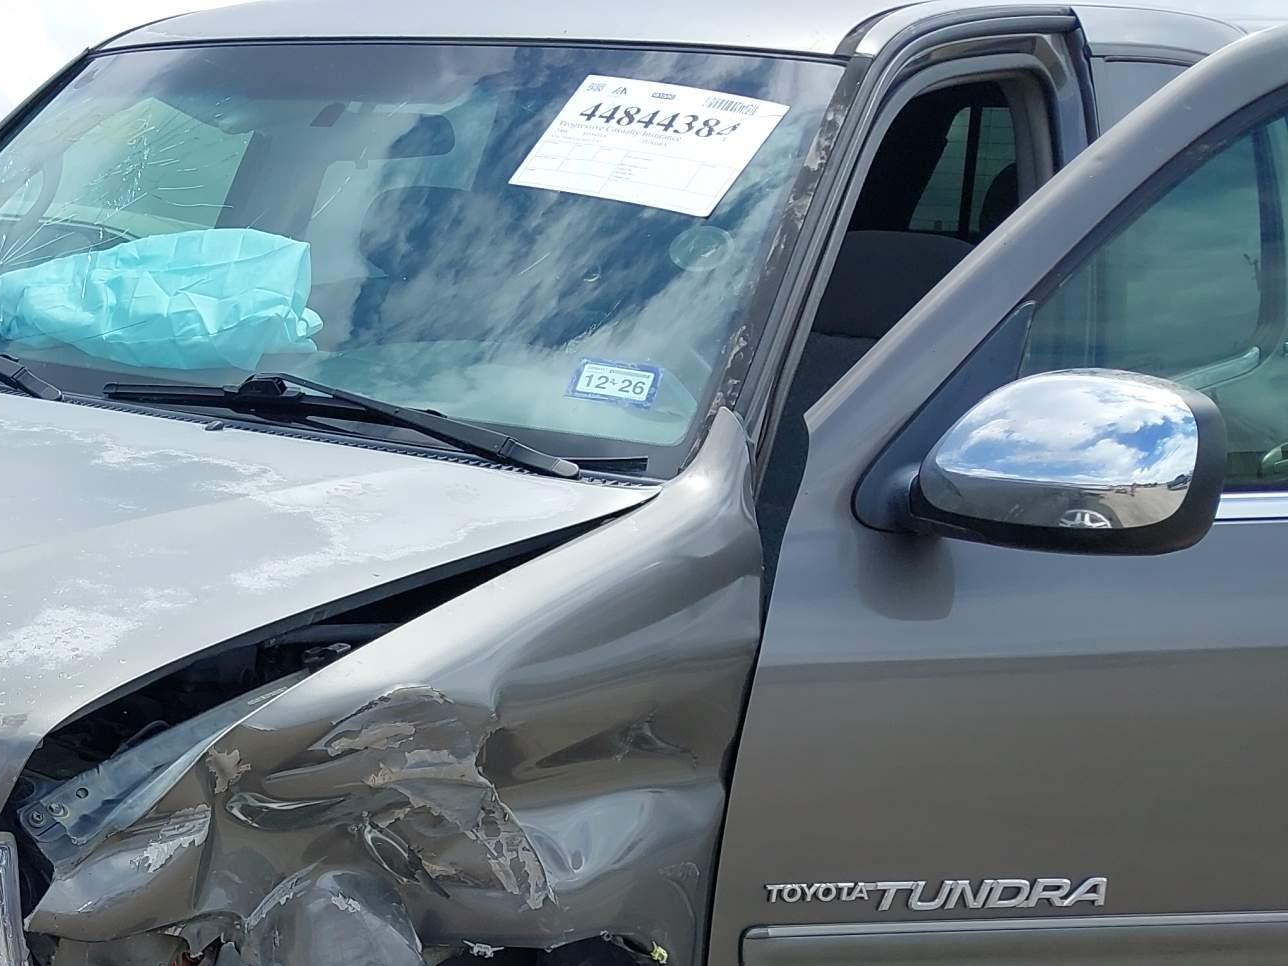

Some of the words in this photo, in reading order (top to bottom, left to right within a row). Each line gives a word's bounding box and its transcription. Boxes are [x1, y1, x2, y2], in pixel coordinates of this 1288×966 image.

[579, 102, 741, 138] 44844384
[585, 373, 610, 390] 12
[617, 378, 646, 396] 26
[765, 882, 871, 904] TOYOTA
[867, 876, 1109, 912] TUNDRA
